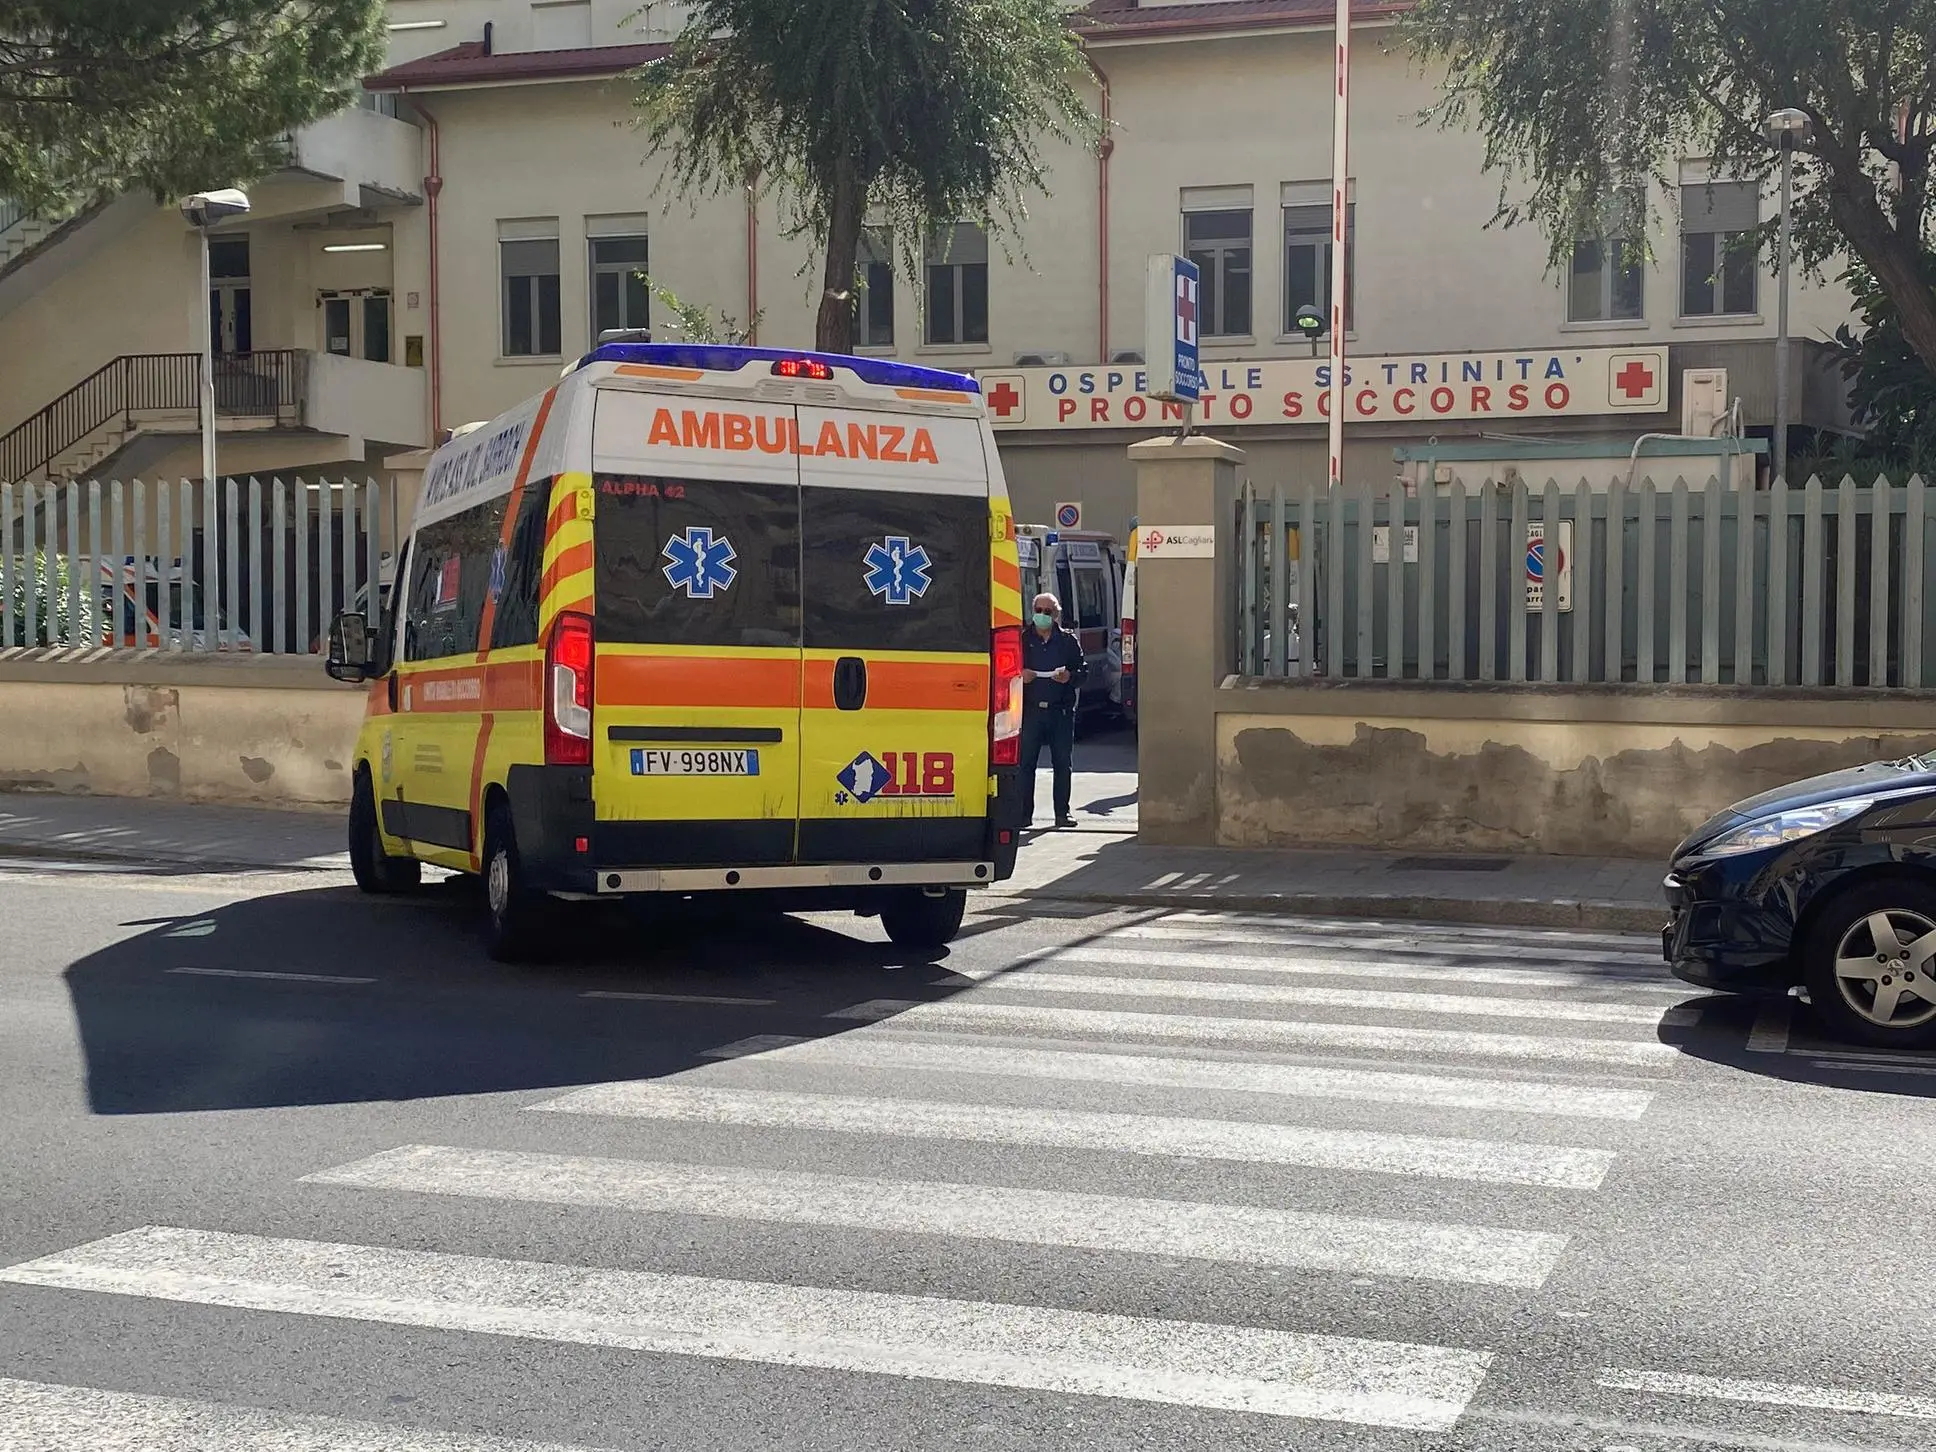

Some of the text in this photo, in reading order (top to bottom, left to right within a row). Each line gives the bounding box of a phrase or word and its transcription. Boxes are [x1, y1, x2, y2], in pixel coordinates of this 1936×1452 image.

[1177, 354, 1196, 371] PRONTO
[1048, 367, 1263, 395] OSPEALE
[1175, 371, 1198, 390] SOCCORSO
[1058, 393, 1253, 423] PRONTO
[647, 408, 939, 464] AMBULANZA
[601, 479, 685, 499] ALPHA 42
[881, 752, 955, 794] 118
